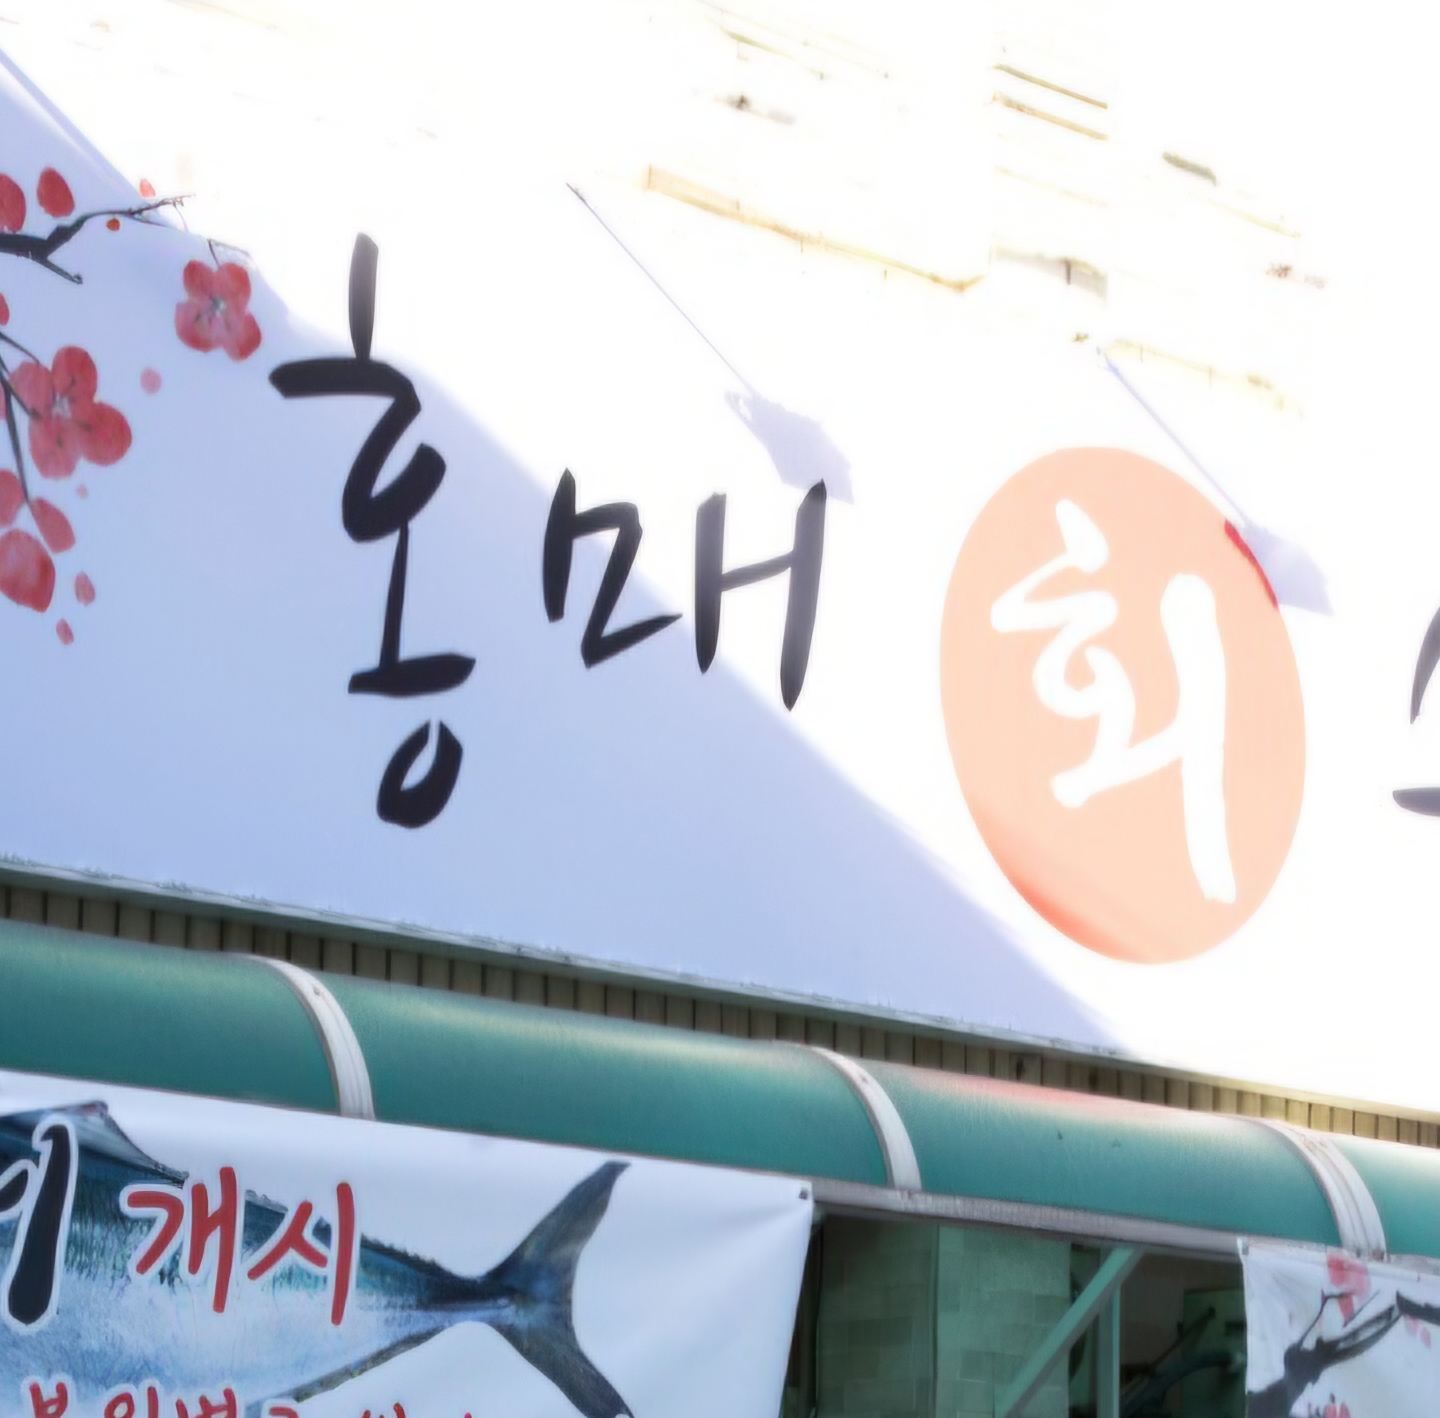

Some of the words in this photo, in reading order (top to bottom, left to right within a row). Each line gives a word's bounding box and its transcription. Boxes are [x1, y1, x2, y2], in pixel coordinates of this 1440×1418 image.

[268, 233, 827, 829] 홍매
[990, 498, 1238, 905] 회
[126, 1164, 360, 1326] 개시
